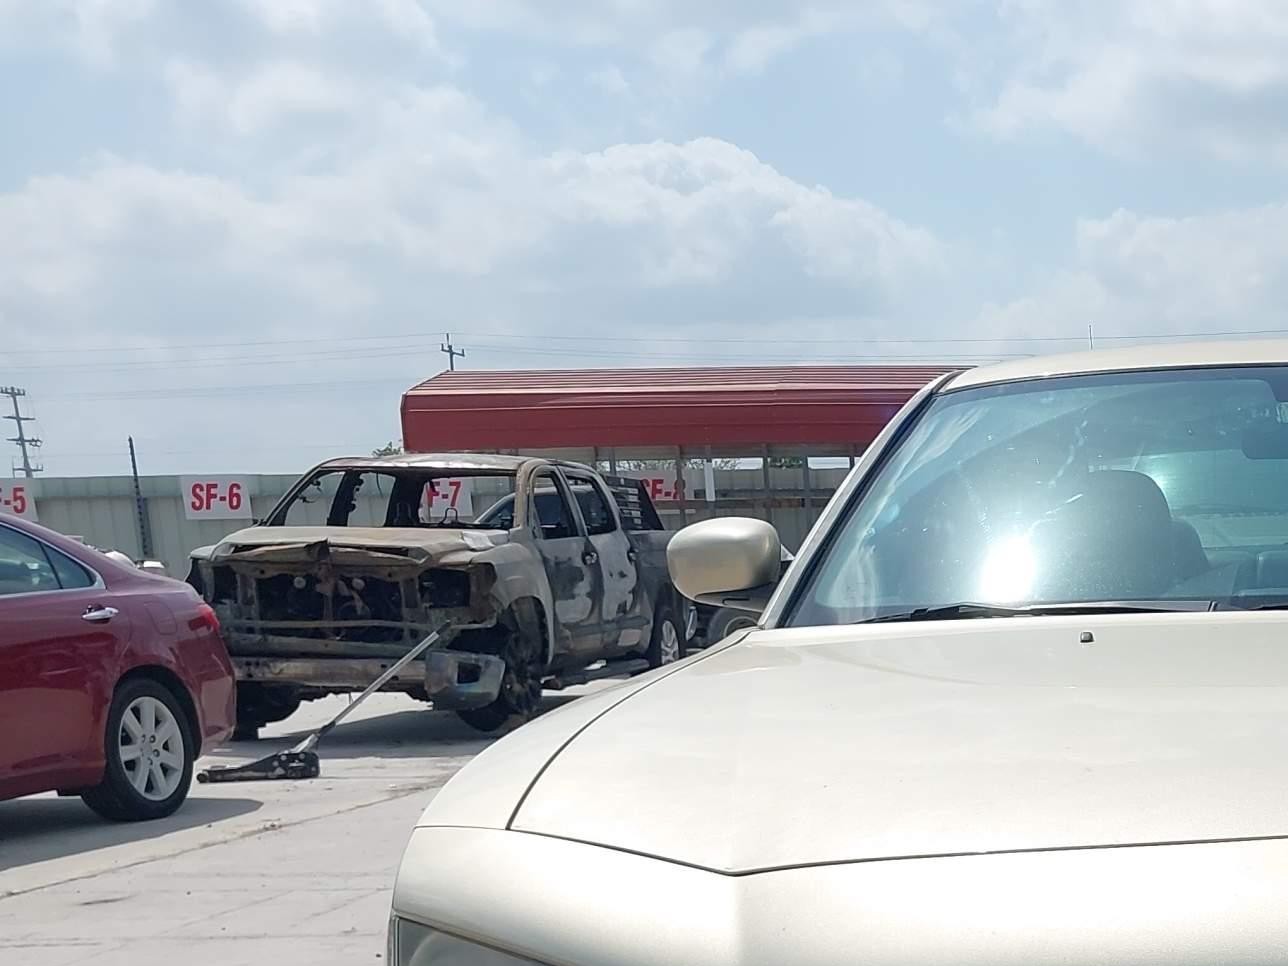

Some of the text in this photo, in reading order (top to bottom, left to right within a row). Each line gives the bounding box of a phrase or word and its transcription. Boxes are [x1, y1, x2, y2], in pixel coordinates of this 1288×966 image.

[0, 487, 26, 513] -5
[191, 483, 242, 511] SF-6
[427, 480, 461, 507] F-7
